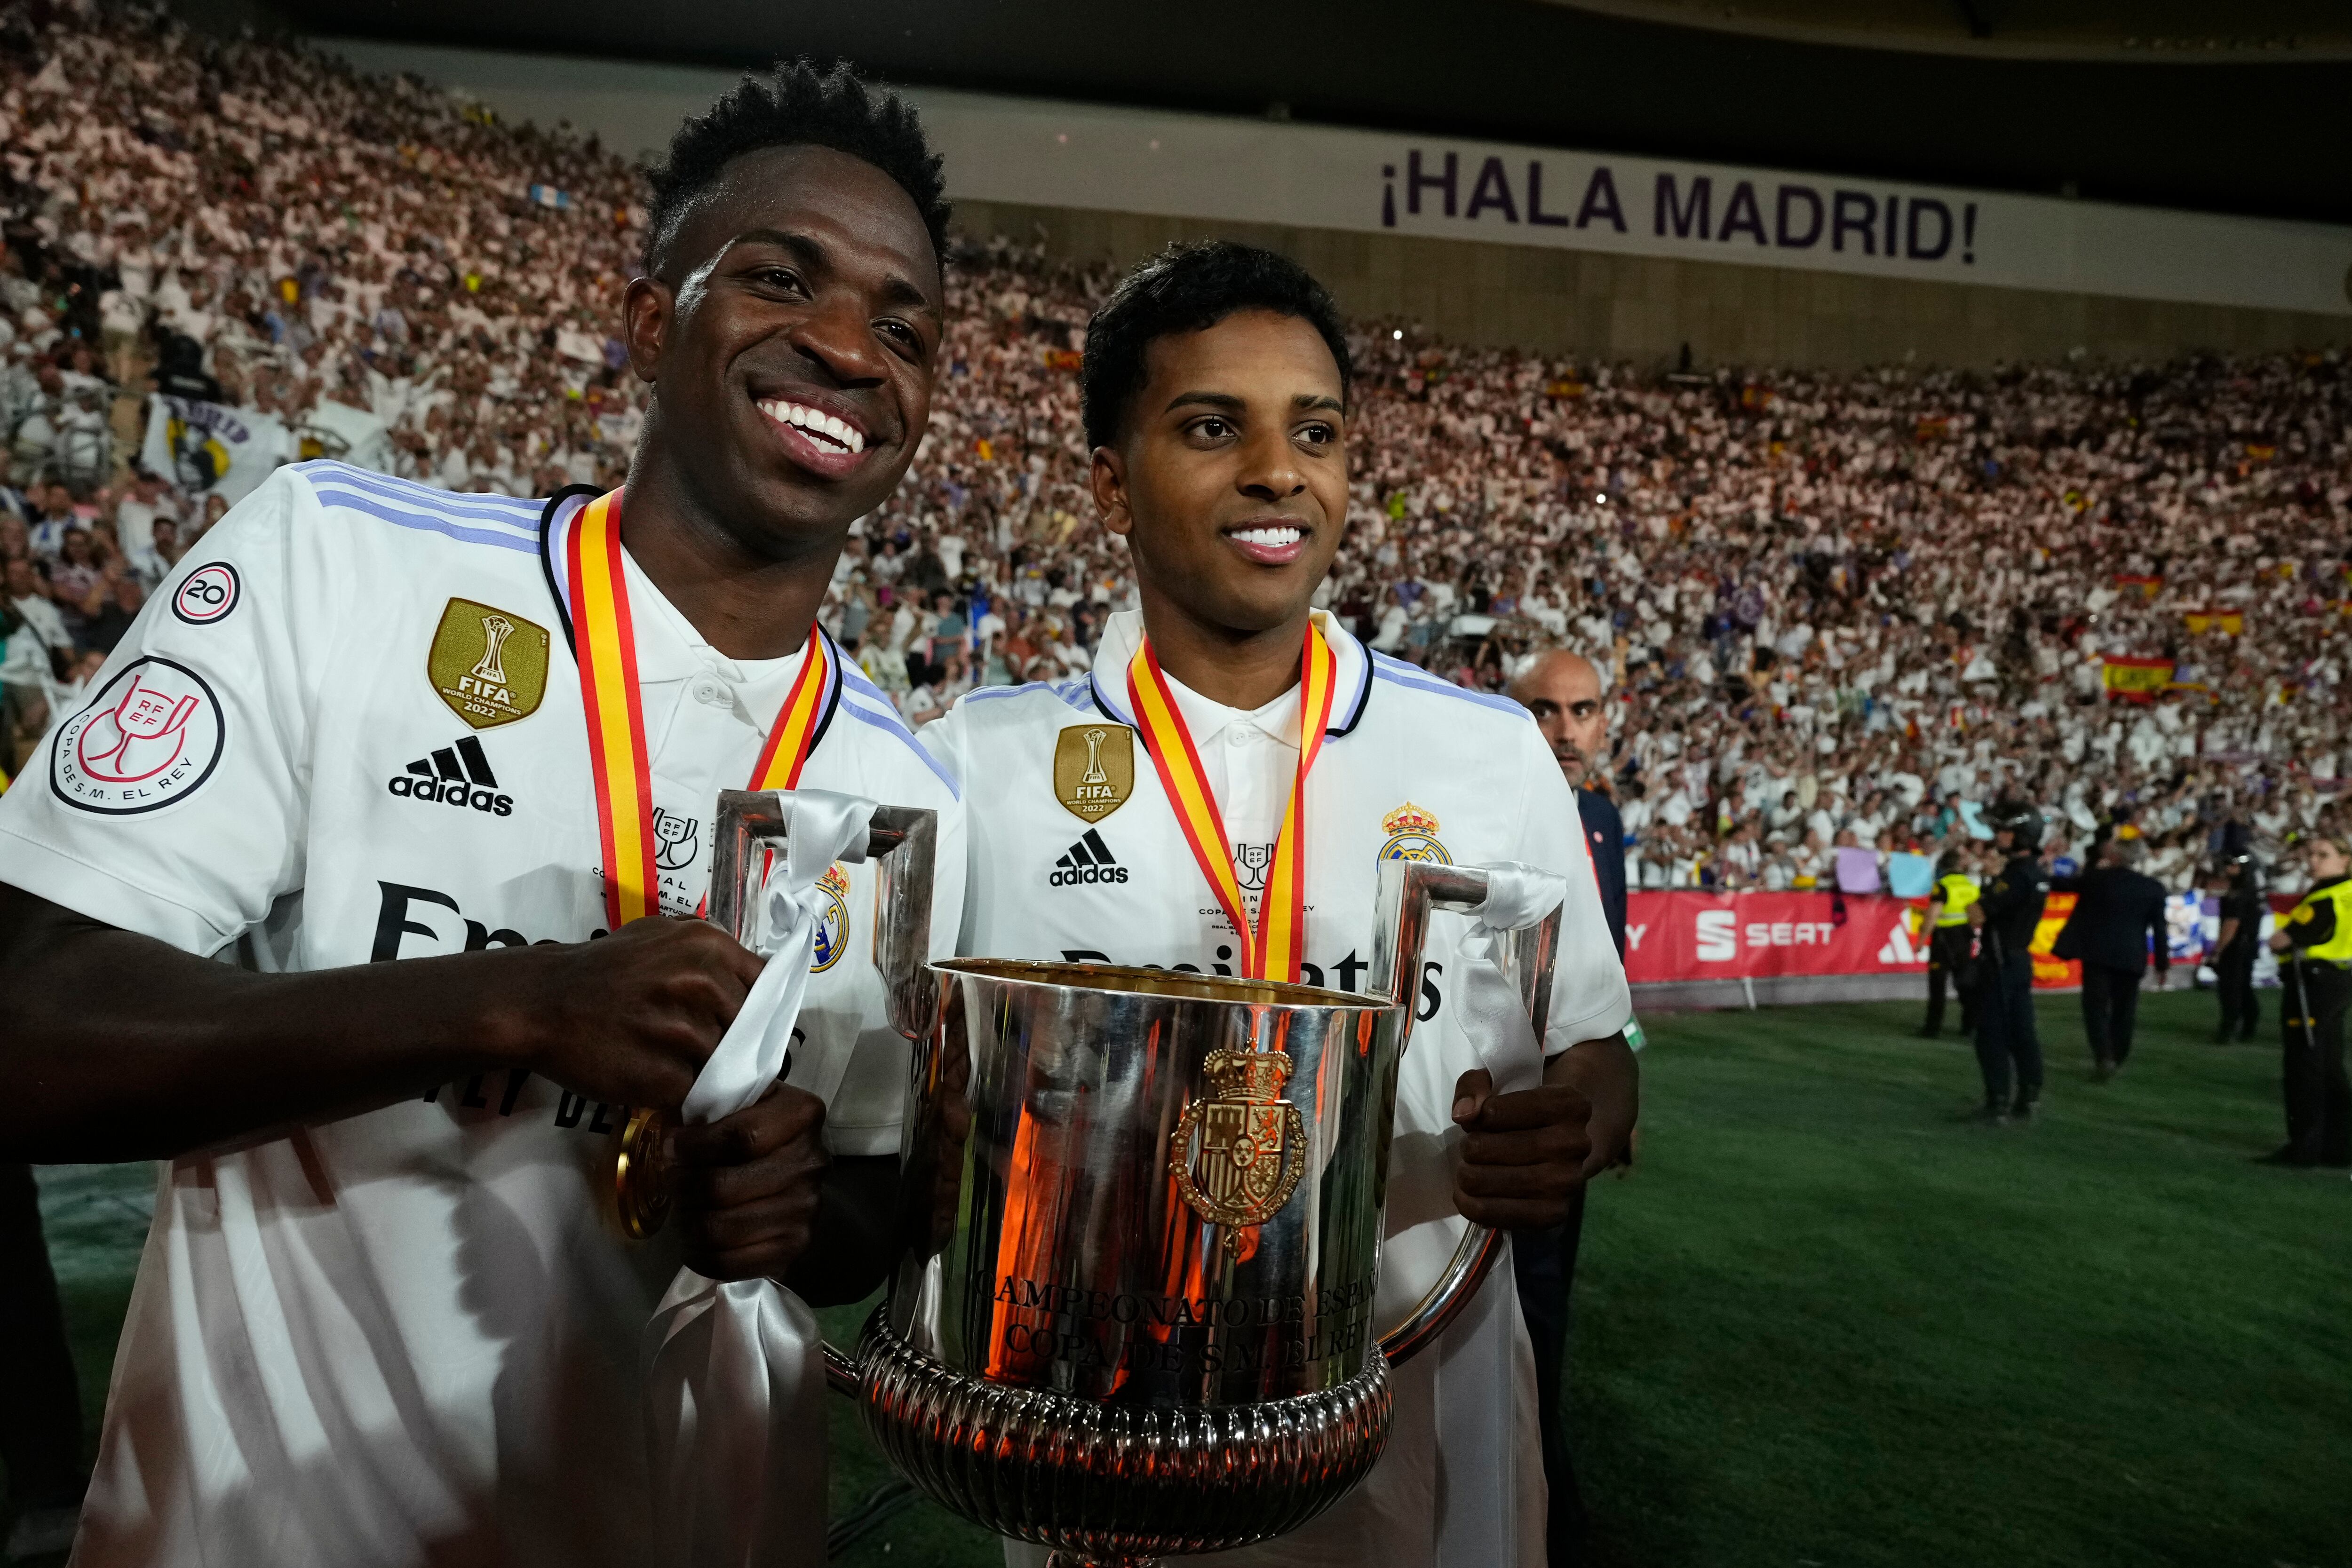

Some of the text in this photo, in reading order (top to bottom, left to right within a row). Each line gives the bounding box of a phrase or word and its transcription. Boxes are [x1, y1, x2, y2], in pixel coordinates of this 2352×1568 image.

[1382, 149, 1979, 264] ¡HALA MADRID!
[186, 579, 225, 604] 20
[442, 688, 522, 715] WORLD CHAMPIONS
[464, 701, 496, 718] 2022
[63, 714, 90, 759] COPA
[63, 765, 76, 784] DE
[158, 757, 192, 789] REY
[123, 788, 151, 800] EL
[388, 776, 514, 816] adidas
[593, 867, 605, 878] CO
[676, 896, 692, 908] EL
[1049, 864, 1128, 887] adidas
[659, 904, 687, 915] ARTUJ
[1746, 922, 1836, 947] SEAT
[974, 1269, 1250, 1326] CAMPEONATO
[1256, 1295, 1306, 1326] DE
[1005, 1324, 1111, 1367] COPA
[1127, 1342, 1184, 1372] DE
[1281, 1335, 1323, 1368] EL
[1327, 1315, 1369, 1357] REY
